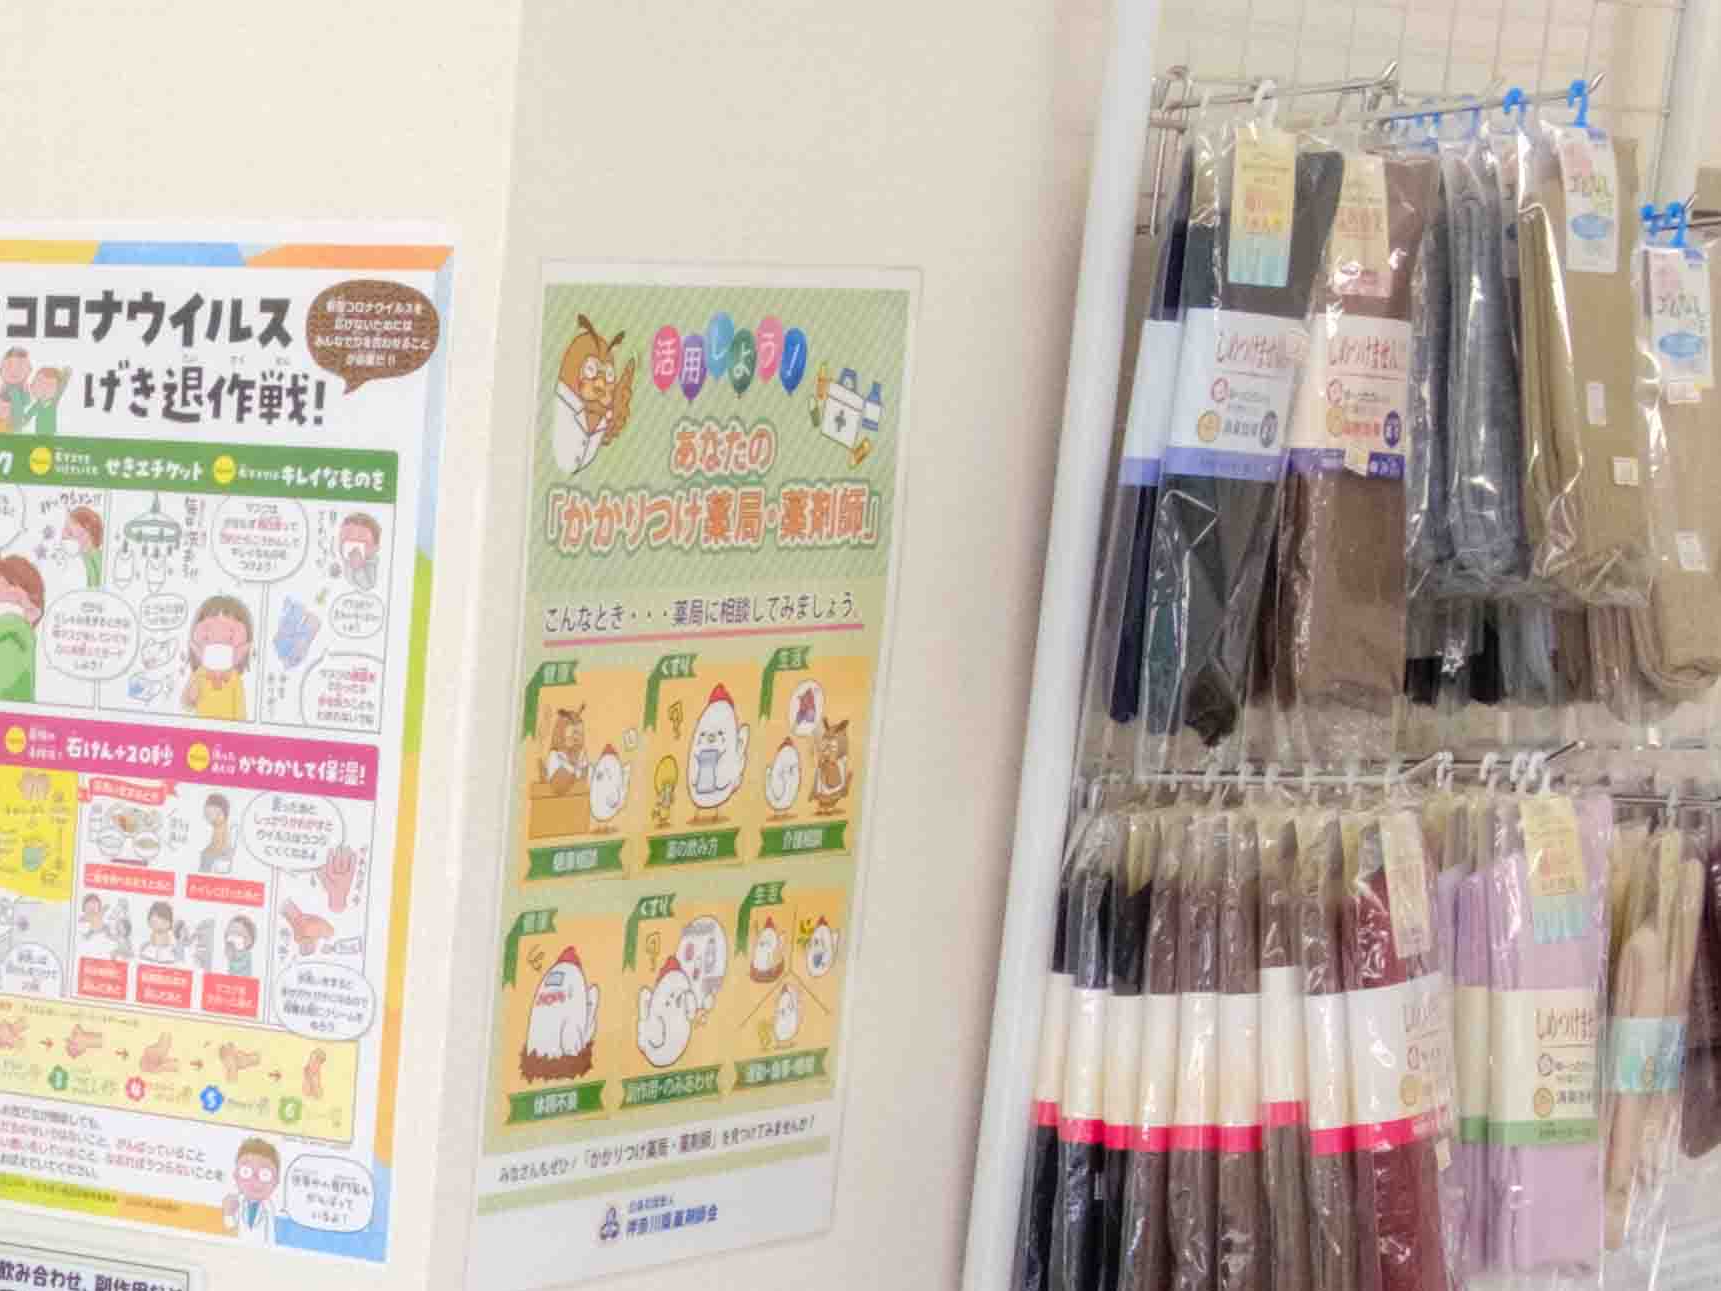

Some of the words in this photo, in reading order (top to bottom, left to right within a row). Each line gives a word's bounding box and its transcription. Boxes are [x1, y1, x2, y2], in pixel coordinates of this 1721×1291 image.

[654, 324, 804, 390] 活用しよう!
[83, 358, 327, 427] げき退作戦!
[671, 422, 776, 473] あなたの
[104, 456, 204, 483] せきエチケット
[280, 464, 387, 493] キレイなものを
[546, 483, 879, 549] 「かかりつけ薬局・薬剤師」
[544, 592, 858, 633] こんなとき・・・薬局に相談してみましょう。
[66, 735, 175, 767] 石けん+20秒
[237, 753, 368, 787] かわかして保湿!
